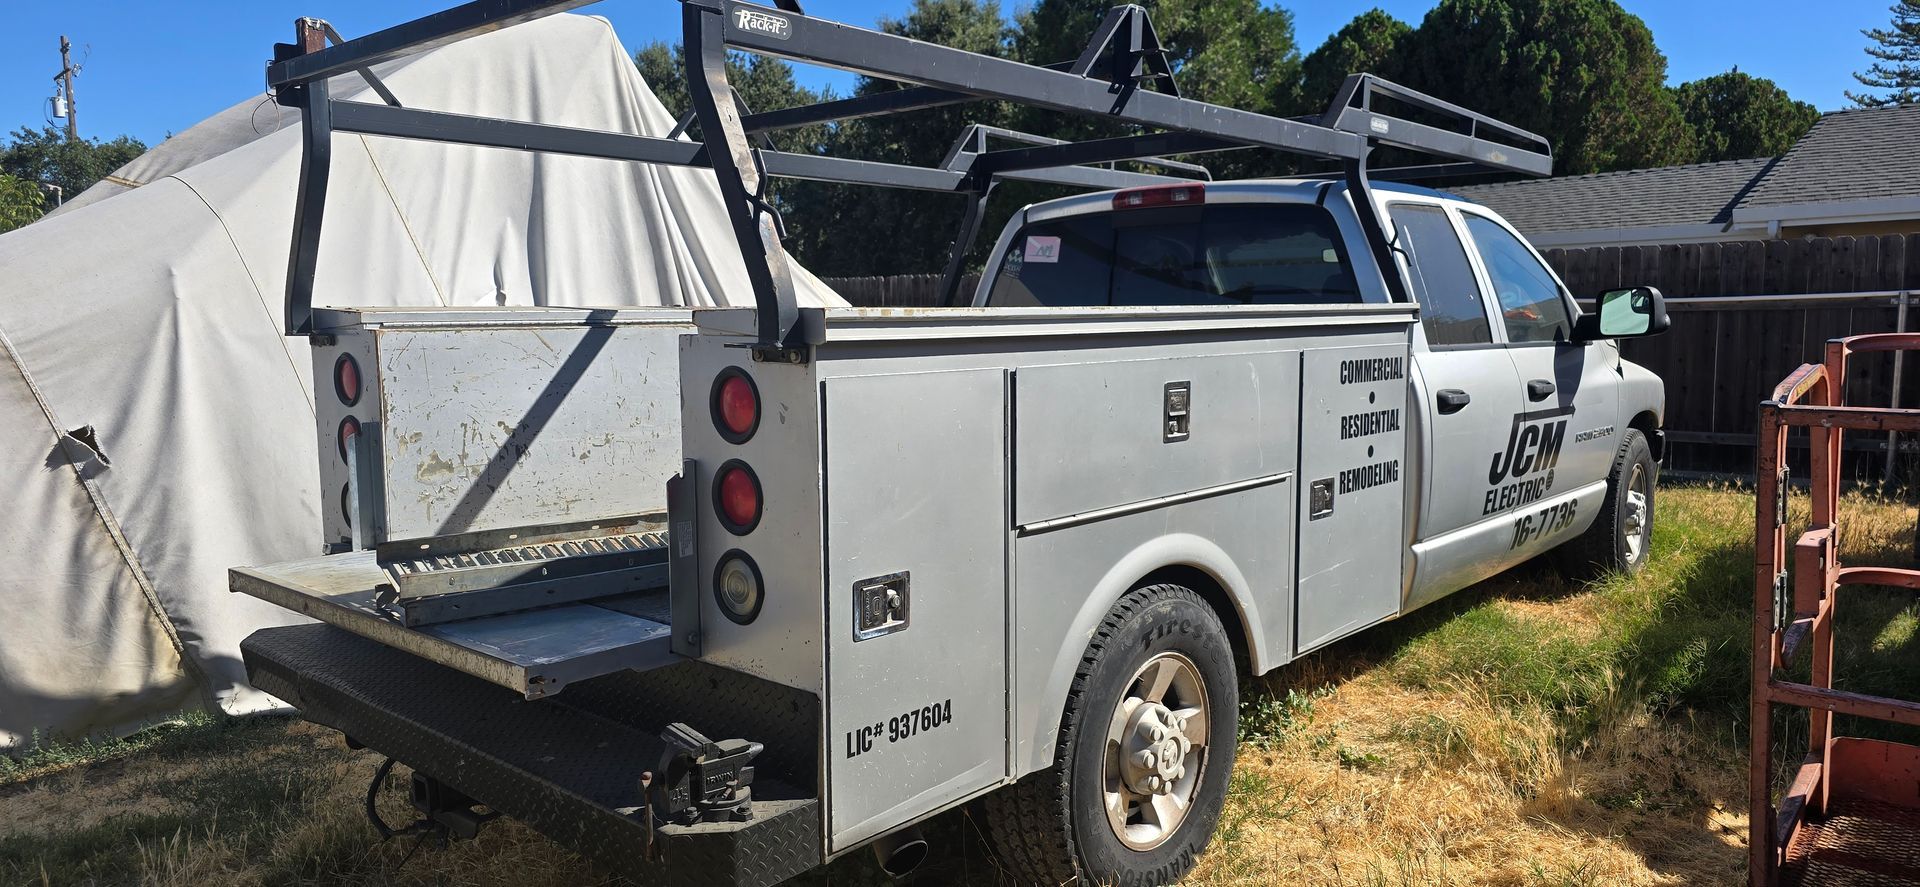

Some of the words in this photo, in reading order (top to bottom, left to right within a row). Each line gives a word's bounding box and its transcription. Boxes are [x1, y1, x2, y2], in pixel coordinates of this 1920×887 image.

[1340, 356, 1403, 385] COMMERCIAL
[1340, 408, 1400, 440] RESIDENTIAL
[1489, 410, 1569, 485] JCM
[1339, 459, 1399, 495] REMODELING
[1482, 476, 1545, 516] ELECTRIC
[1510, 498, 1578, 551] 16-7736
[846, 721, 884, 759] LIC#
[888, 698, 952, 743] 937604
